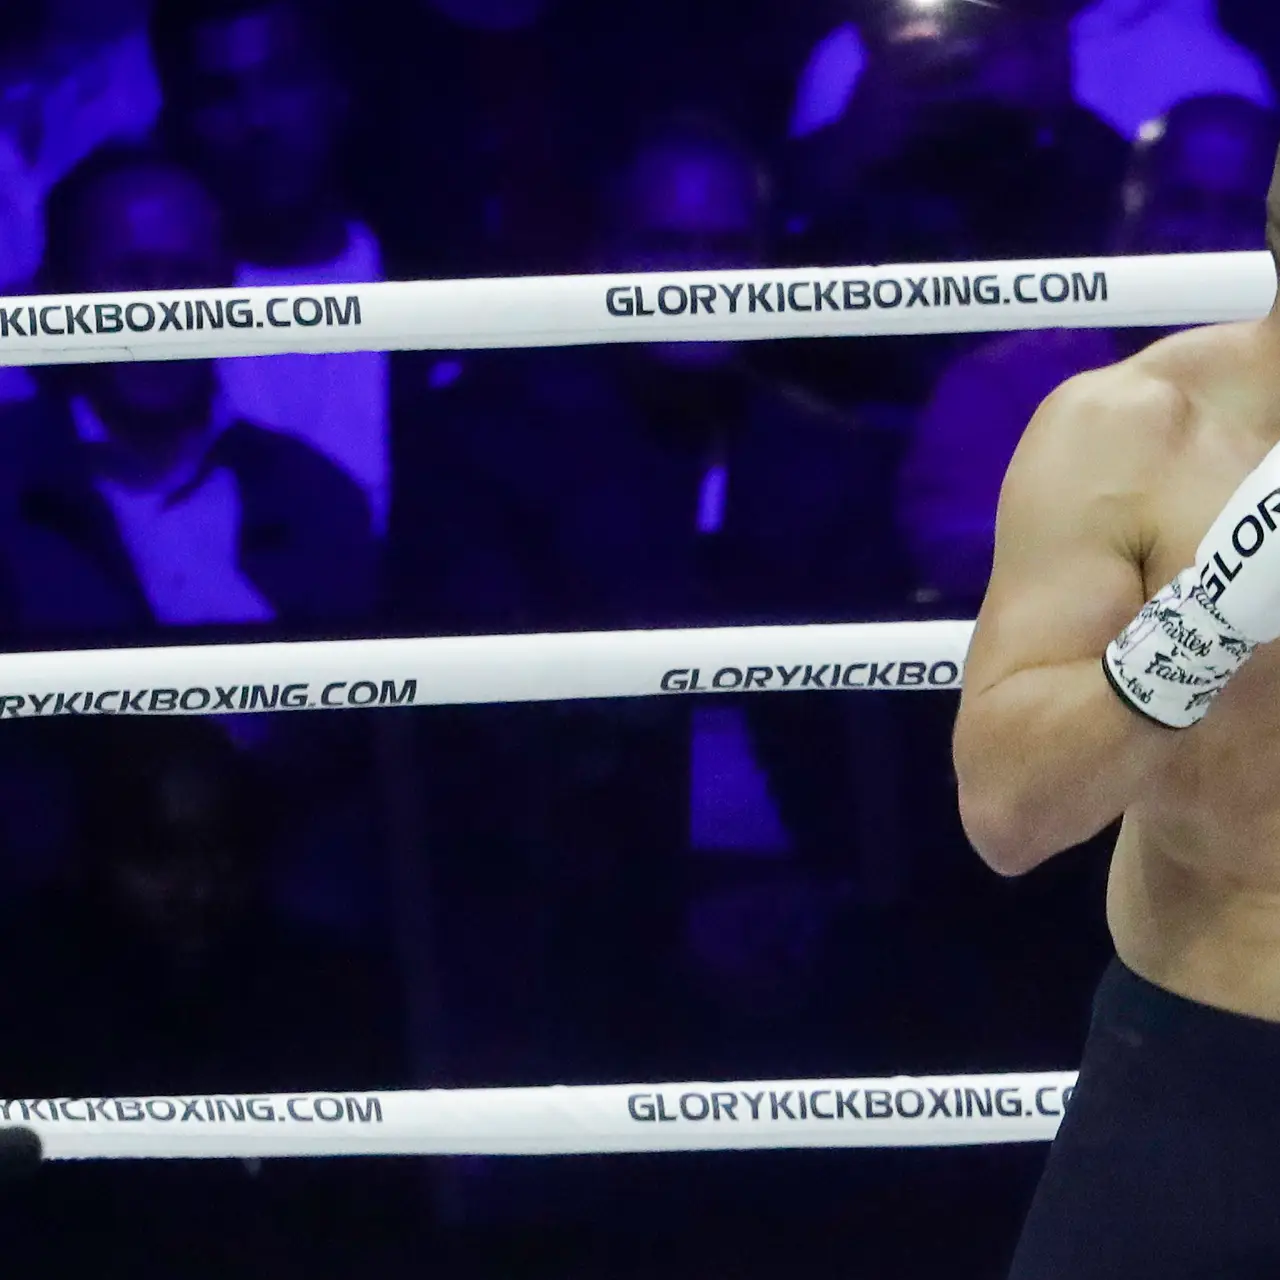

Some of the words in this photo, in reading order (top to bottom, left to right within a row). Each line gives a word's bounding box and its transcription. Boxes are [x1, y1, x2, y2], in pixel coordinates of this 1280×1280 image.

[605, 270, 1109, 317] GLORYKICKBOXING.COM
[0, 295, 363, 337] KICKBOXING.COM
[660, 660, 964, 691] GLORYKICKBO
